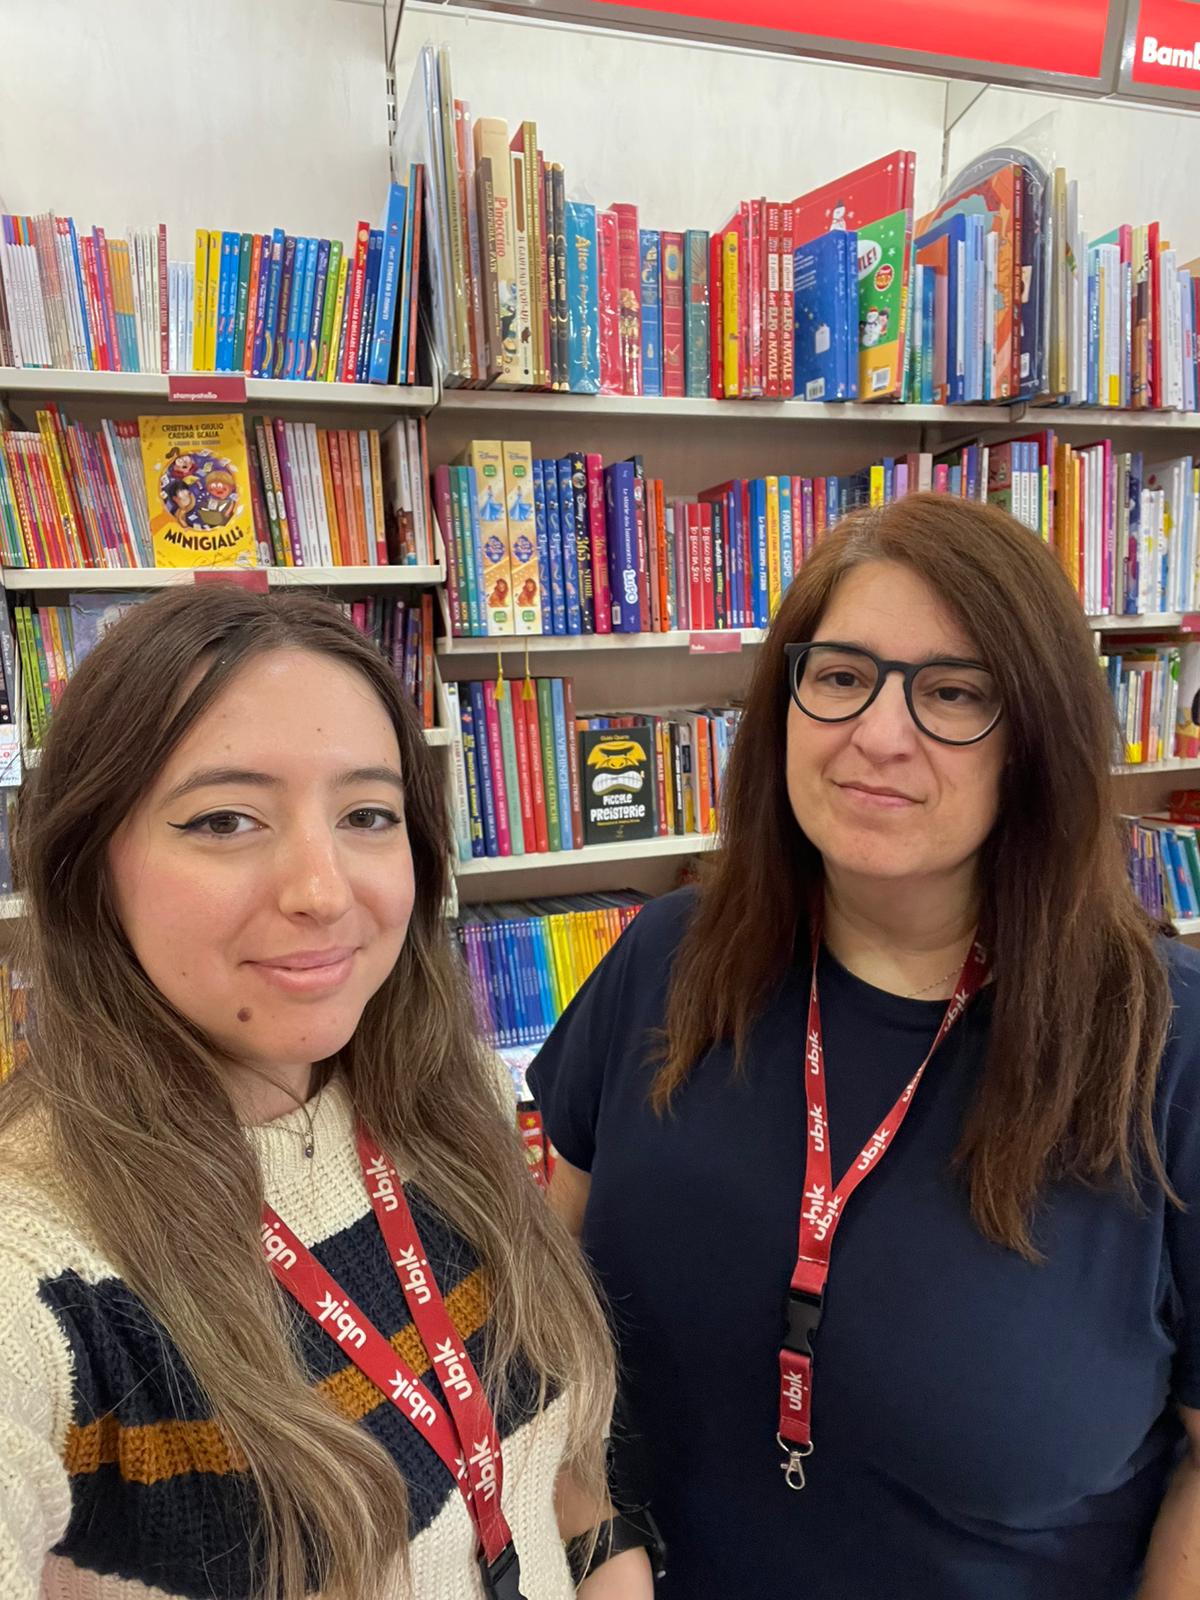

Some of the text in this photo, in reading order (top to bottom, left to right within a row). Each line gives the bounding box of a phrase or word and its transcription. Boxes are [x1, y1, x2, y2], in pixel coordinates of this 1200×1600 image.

[769, 340, 779, 380] NATALE
[784, 340, 793, 380] NATALE
[576, 536, 590, 561] 365
[783, 510, 792, 577] FAVOLE ESOPO
[623, 570, 638, 604] LUPO
[805, 1029, 822, 1076] ubik
[809, 1103, 828, 1153] ubik
[857, 1127, 890, 1172] ubik
[366, 1155, 398, 1212] ubik
[814, 1194, 843, 1242] ubik
[261, 1222, 298, 1270] ubi
[396, 1244, 432, 1305] ubik
[316, 1290, 368, 1349] ubik
[433, 1336, 473, 1401] ubik
[783, 1370, 809, 1411] ubik
[388, 1369, 437, 1427] ubik
[469, 1434, 501, 1502] ubik
